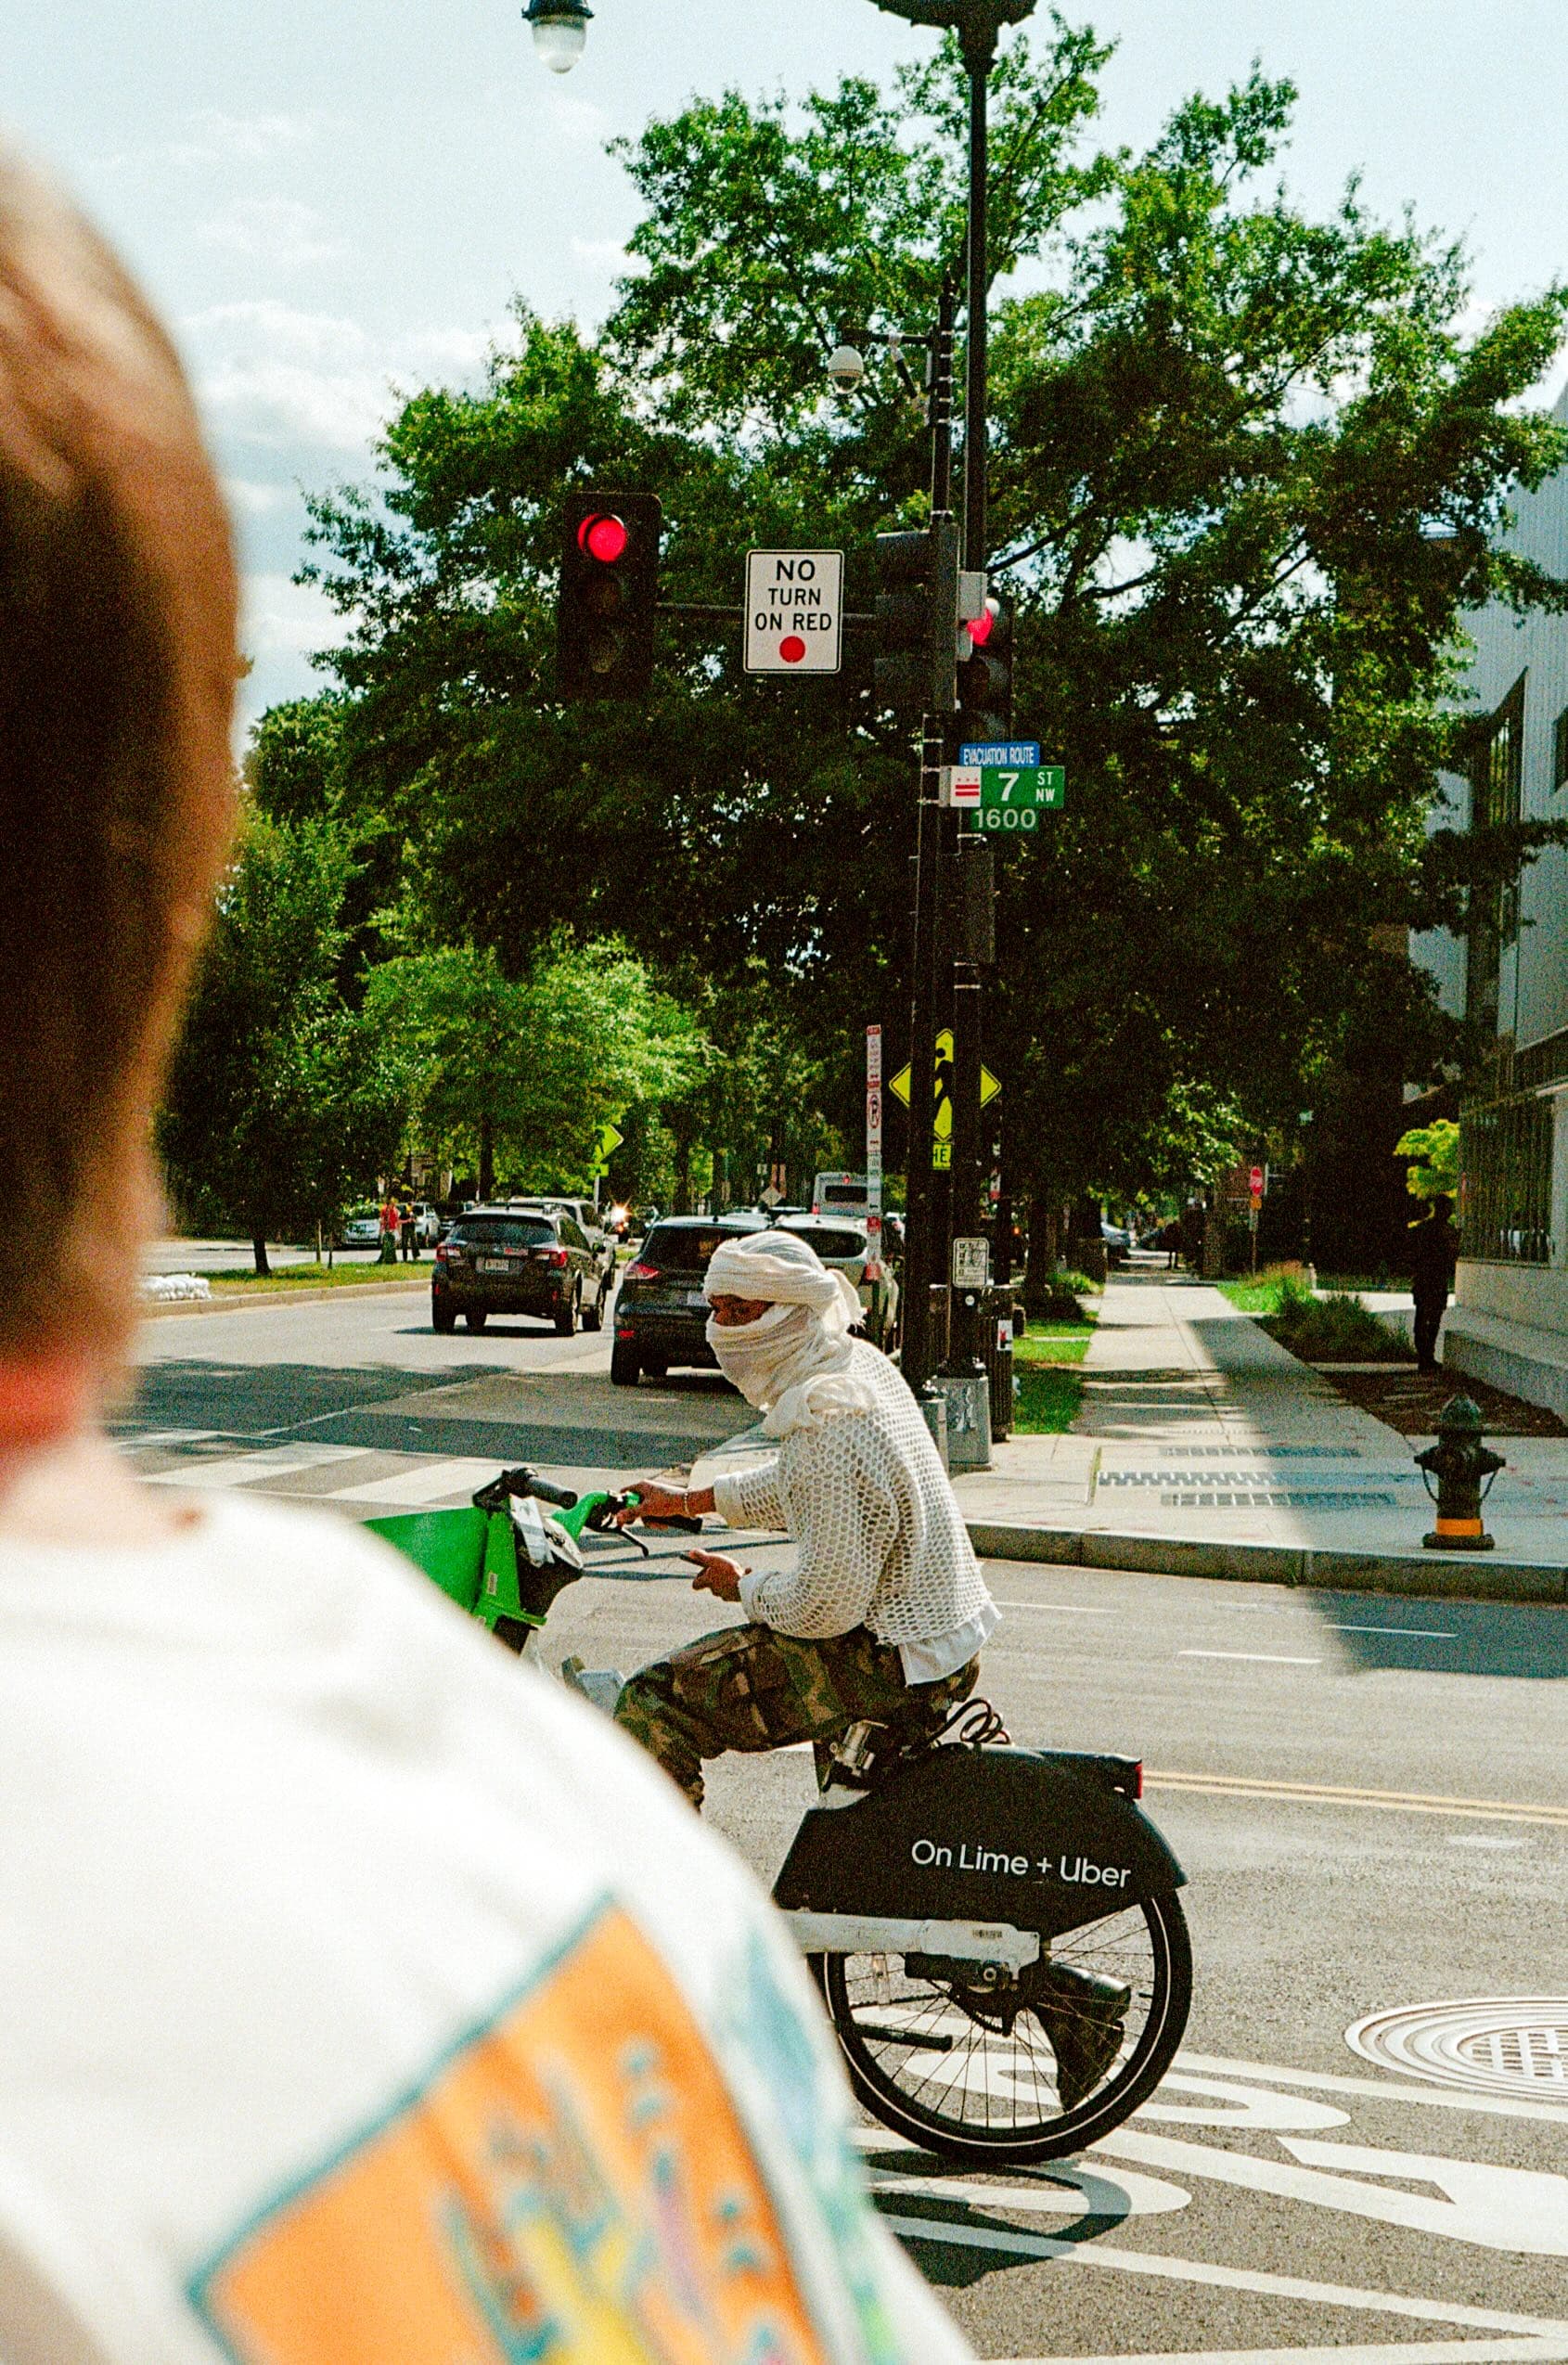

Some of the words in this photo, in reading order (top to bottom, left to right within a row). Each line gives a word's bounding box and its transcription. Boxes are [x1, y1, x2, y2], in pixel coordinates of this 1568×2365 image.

[776, 559, 816, 582] NO
[767, 587, 822, 606] TURN
[754, 612, 783, 631] ON
[792, 612, 832, 632] RED
[963, 747, 1008, 765] EVACUATION
[1009, 745, 1035, 765] ROUTE
[997, 772, 1020, 803] 7
[1037, 771, 1054, 786] ST
[1035, 789, 1056, 803] NW
[975, 808, 1037, 829] 1600
[911, 1839, 953, 1868] On
[958, 1843, 1029, 1876] Lime
[1036, 1856, 1053, 1874] +
[1060, 1855, 1132, 1889] Uber
